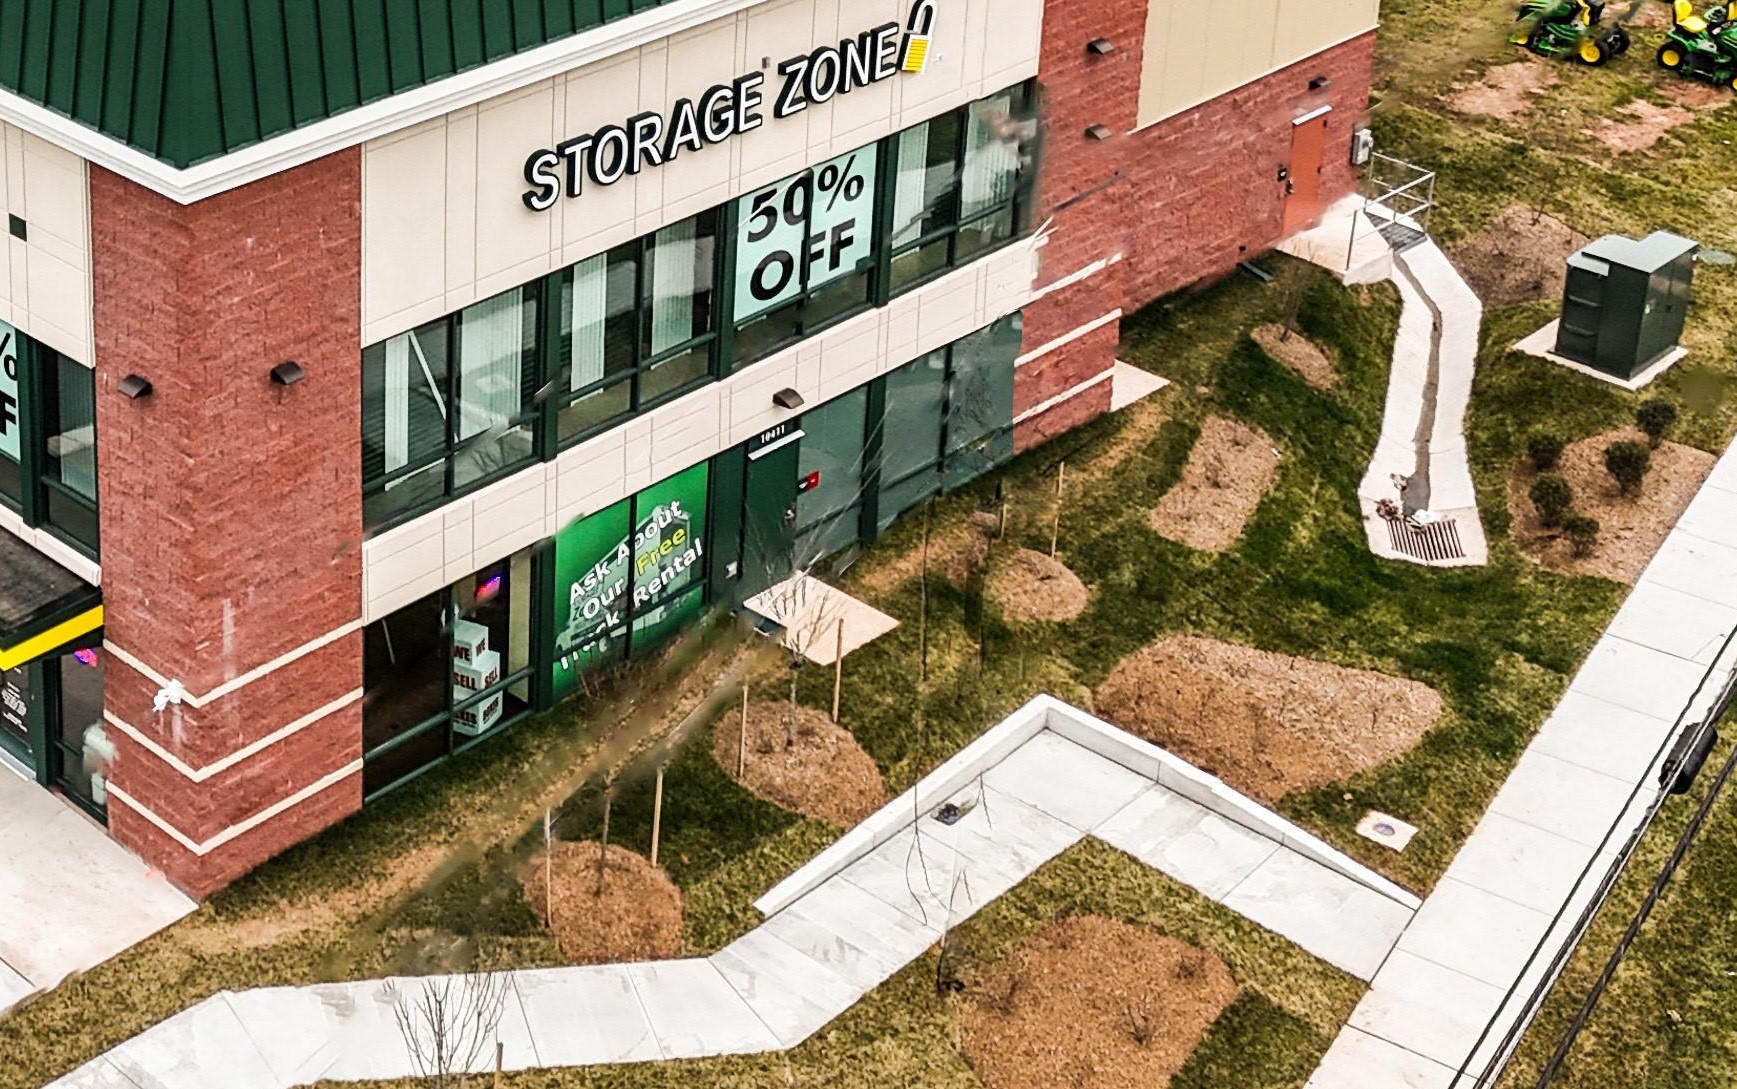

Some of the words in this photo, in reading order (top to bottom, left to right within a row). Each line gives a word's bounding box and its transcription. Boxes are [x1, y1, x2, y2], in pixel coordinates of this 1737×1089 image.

[522, 70, 764, 212] STORAGE
[774, 21, 900, 119] ZONE
[747, 154, 865, 243] 50%
[750, 217, 856, 301] OFF
[761, 424, 785, 443] 10411
[570, 560, 611, 606] Ask
[582, 578, 625, 620] Our
[636, 528, 687, 576] Free
[633, 537, 703, 609] Rental
